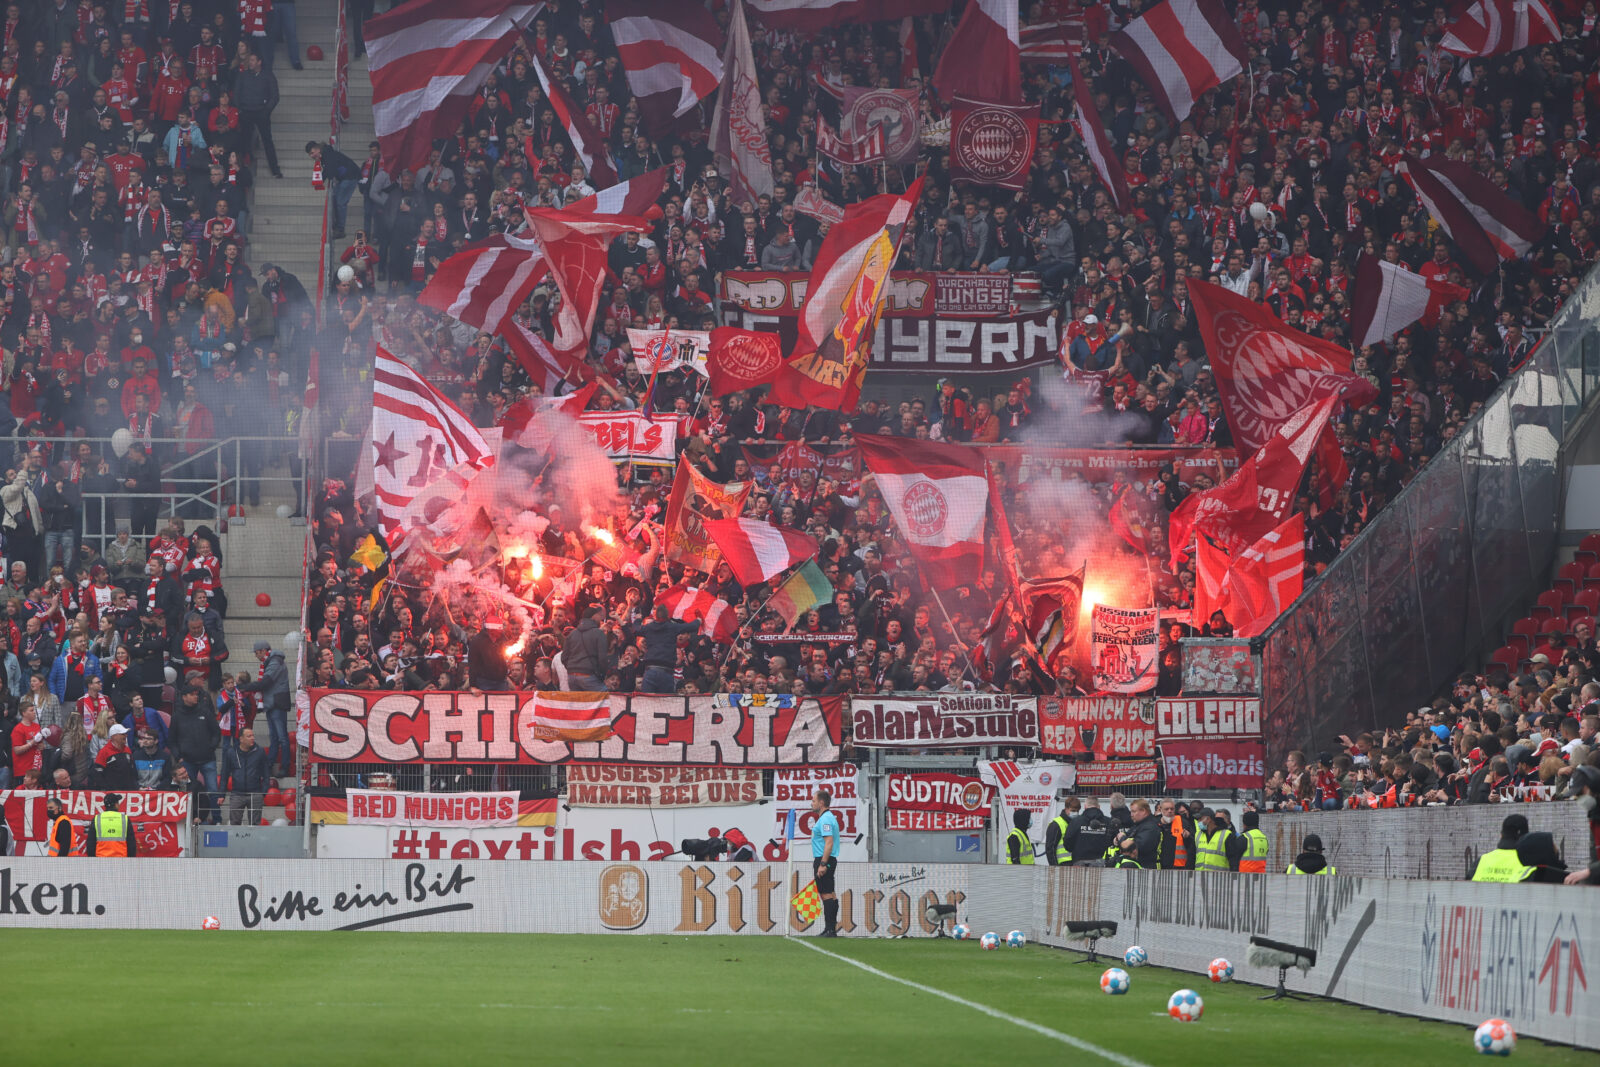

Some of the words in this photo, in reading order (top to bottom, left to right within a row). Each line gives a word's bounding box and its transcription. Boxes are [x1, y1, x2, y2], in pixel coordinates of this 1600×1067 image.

[962, 144, 1006, 175] MÜNCHEN
[725, 278, 787, 310] RED
[938, 288, 1009, 304] JUNGS!
[940, 697, 992, 712] Sektion
[994, 695, 1011, 709] SV
[1157, 700, 1261, 735] COLEGIO
[1044, 725, 1076, 751] RED
[1103, 728, 1155, 756] PRIDE
[778, 769, 810, 781] WIR
[814, 764, 857, 780] SIND
[1166, 753, 1265, 777] Rhoibazis
[1078, 775, 1107, 784] IMMER
[567, 783, 651, 806] IMMER
[661, 783, 701, 804] BEI
[707, 781, 758, 803] UNS
[776, 785, 814, 801] BEI
[890, 774, 992, 811] SÜDTIROL
[353, 795, 397, 819] RED
[888, 810, 943, 830] LETZTE
[945, 811, 984, 829] REIHE
[238, 883, 324, 929] Bitte
[333, 883, 399, 912] ein
[405, 863, 476, 901] Bit
[1435, 904, 1483, 1014] MEWA
[1482, 907, 1538, 1023] ARENA
